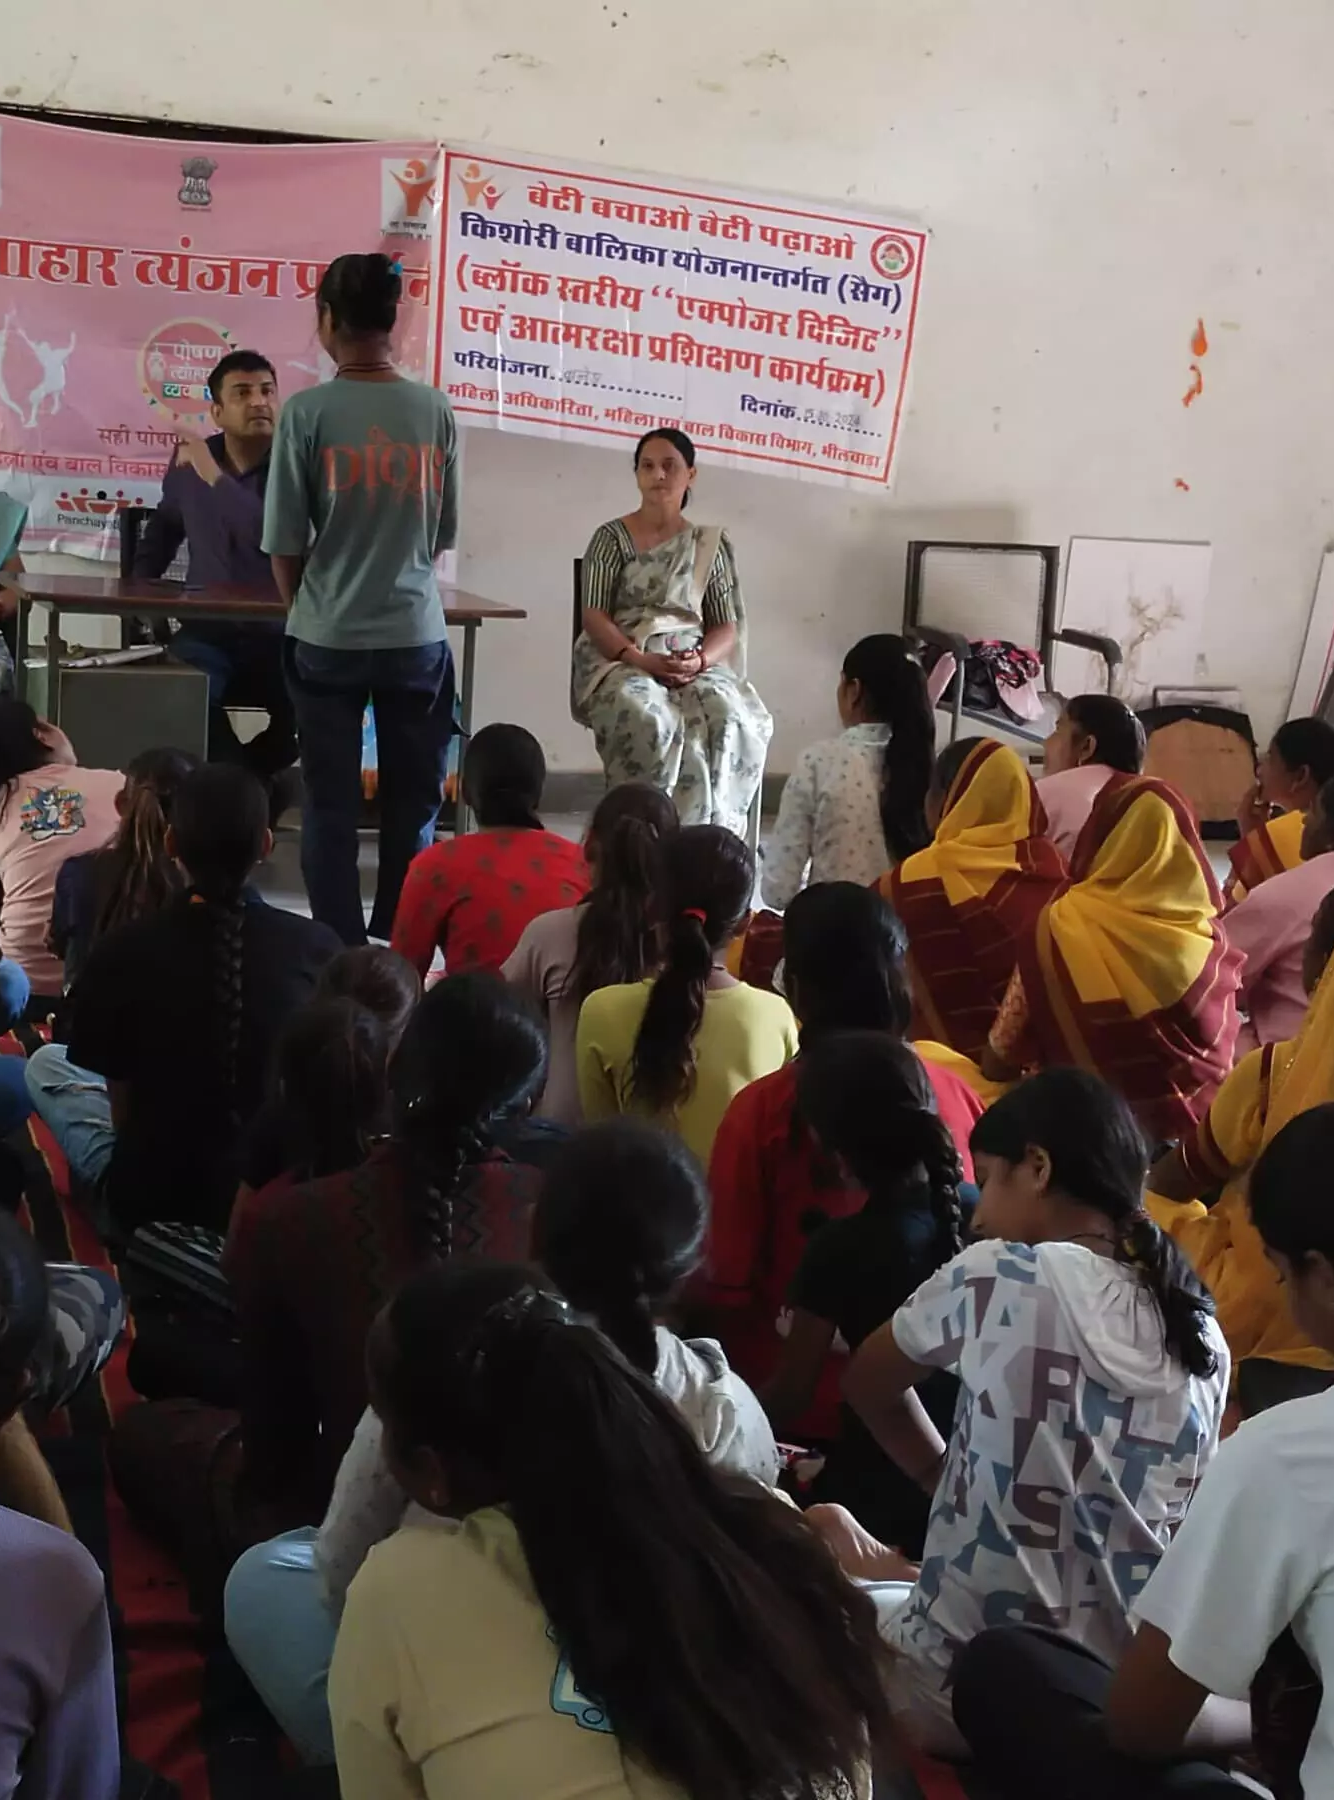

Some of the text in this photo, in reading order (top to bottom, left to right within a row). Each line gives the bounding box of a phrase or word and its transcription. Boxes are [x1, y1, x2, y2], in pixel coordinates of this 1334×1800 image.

[527, 181, 857, 261] बेटी बचाओ बेटी पढ़ाओ
[456, 253, 552, 297] (ब्लॉक
[556, 274, 645, 312] स्तरीय
[460, 211, 903, 314] किशोरी बालिका योजनान्तर्गत (सैग)
[172, 338, 224, 362] पोषण
[459, 303, 886, 407] एवं आत्मरक्षा प्रशिक्षण कार्यक्रम)
[97, 424, 131, 445] सही
[447, 381, 499, 402] महिला
[604, 405, 655, 428] महिला
[684, 422, 715, 437] बाल
[718, 424, 768, 448] विकास
[65, 456, 103, 475] बाल
